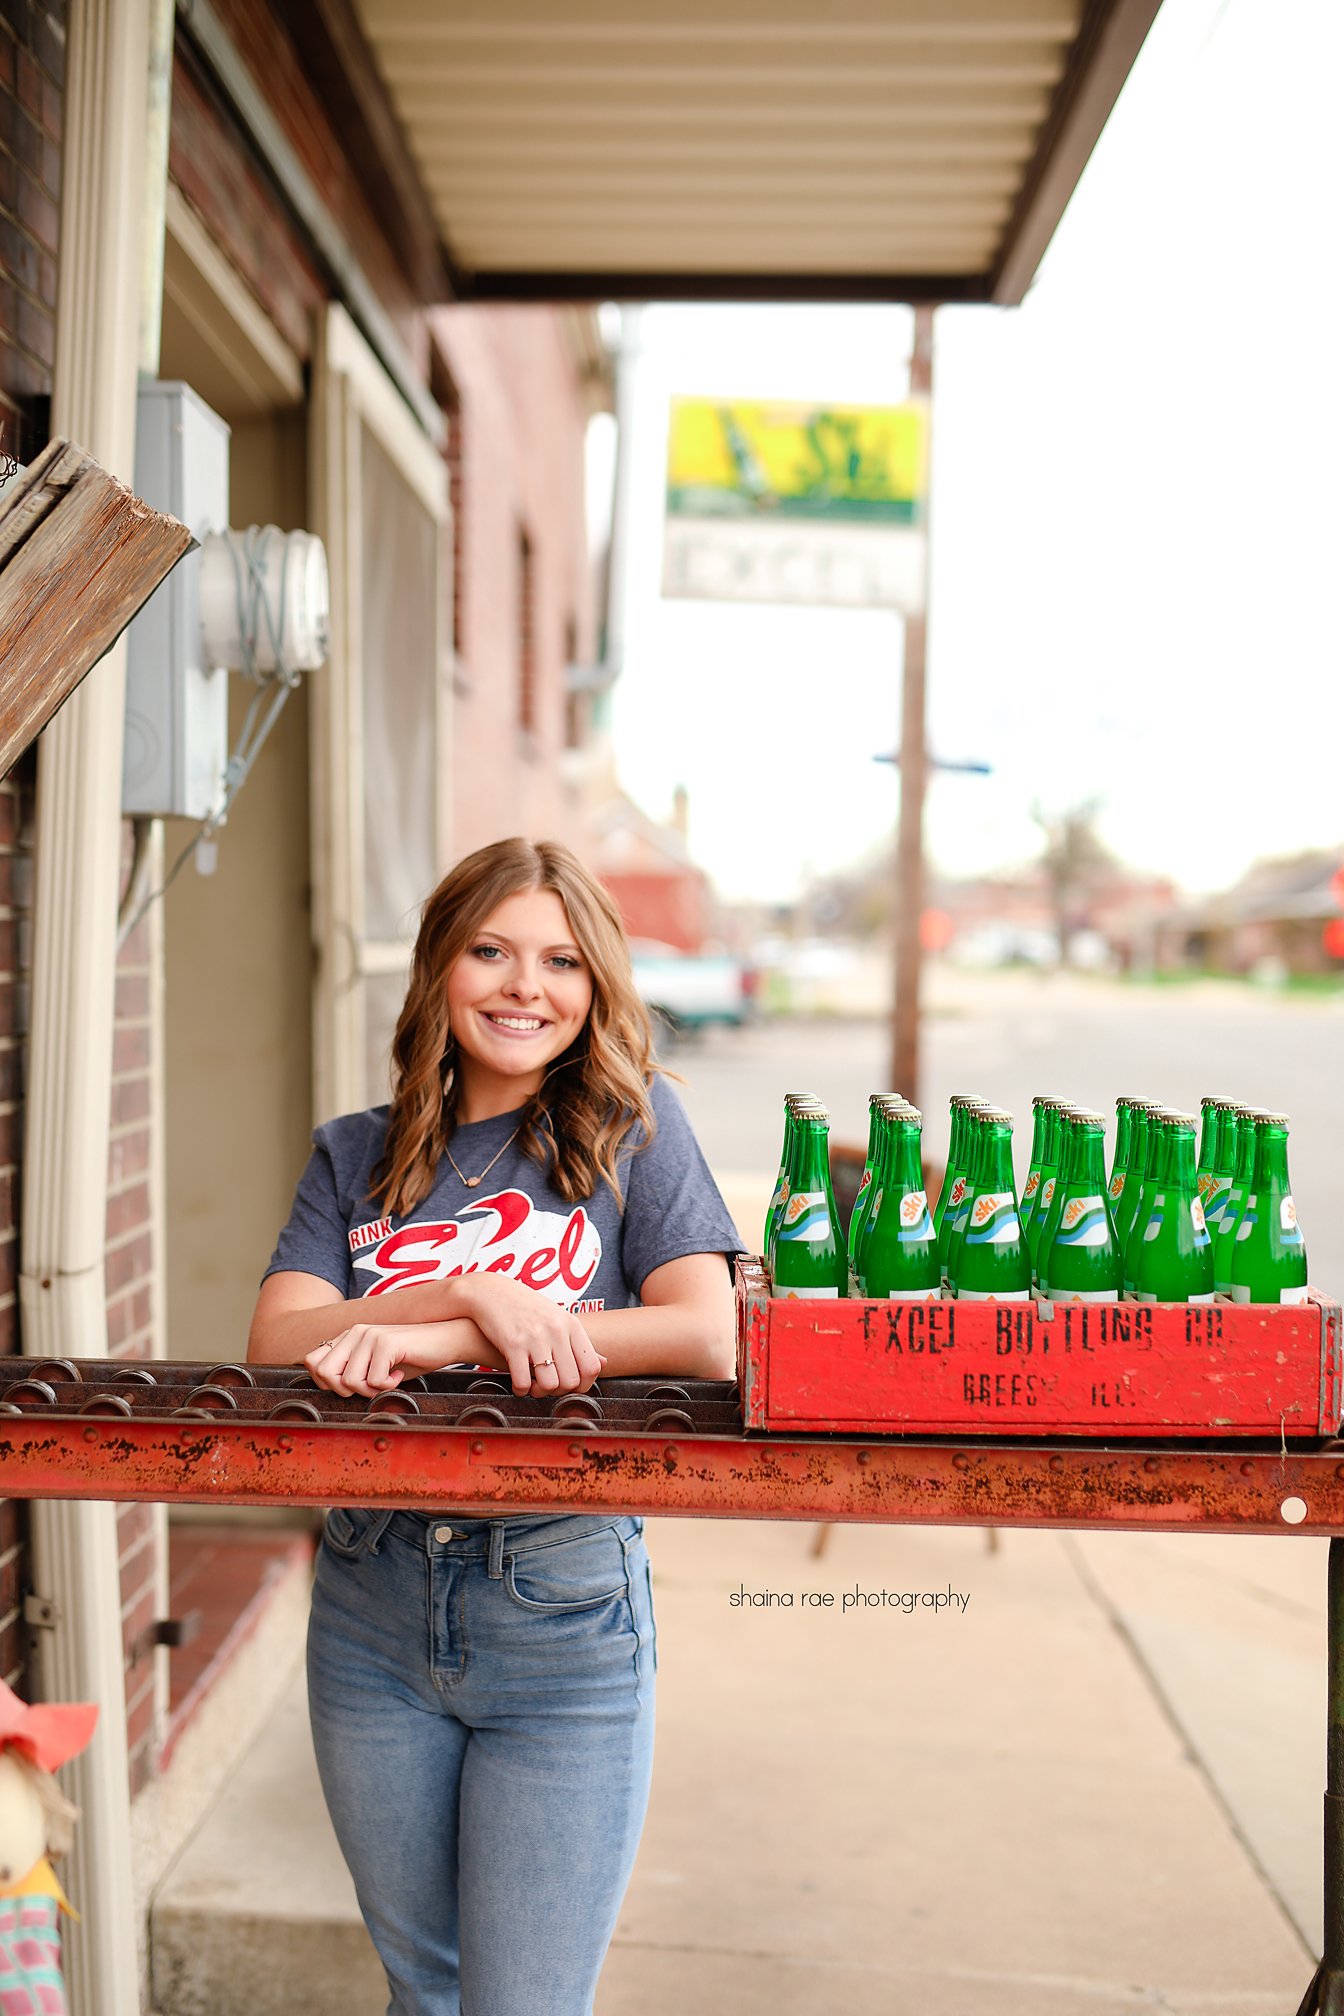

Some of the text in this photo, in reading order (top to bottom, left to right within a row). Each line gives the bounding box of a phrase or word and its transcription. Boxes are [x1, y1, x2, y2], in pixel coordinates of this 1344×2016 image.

[350, 1218, 392, 1250] RINK
[366, 1191, 596, 1297] Eel
[962, 1373, 1058, 1407] BREES
